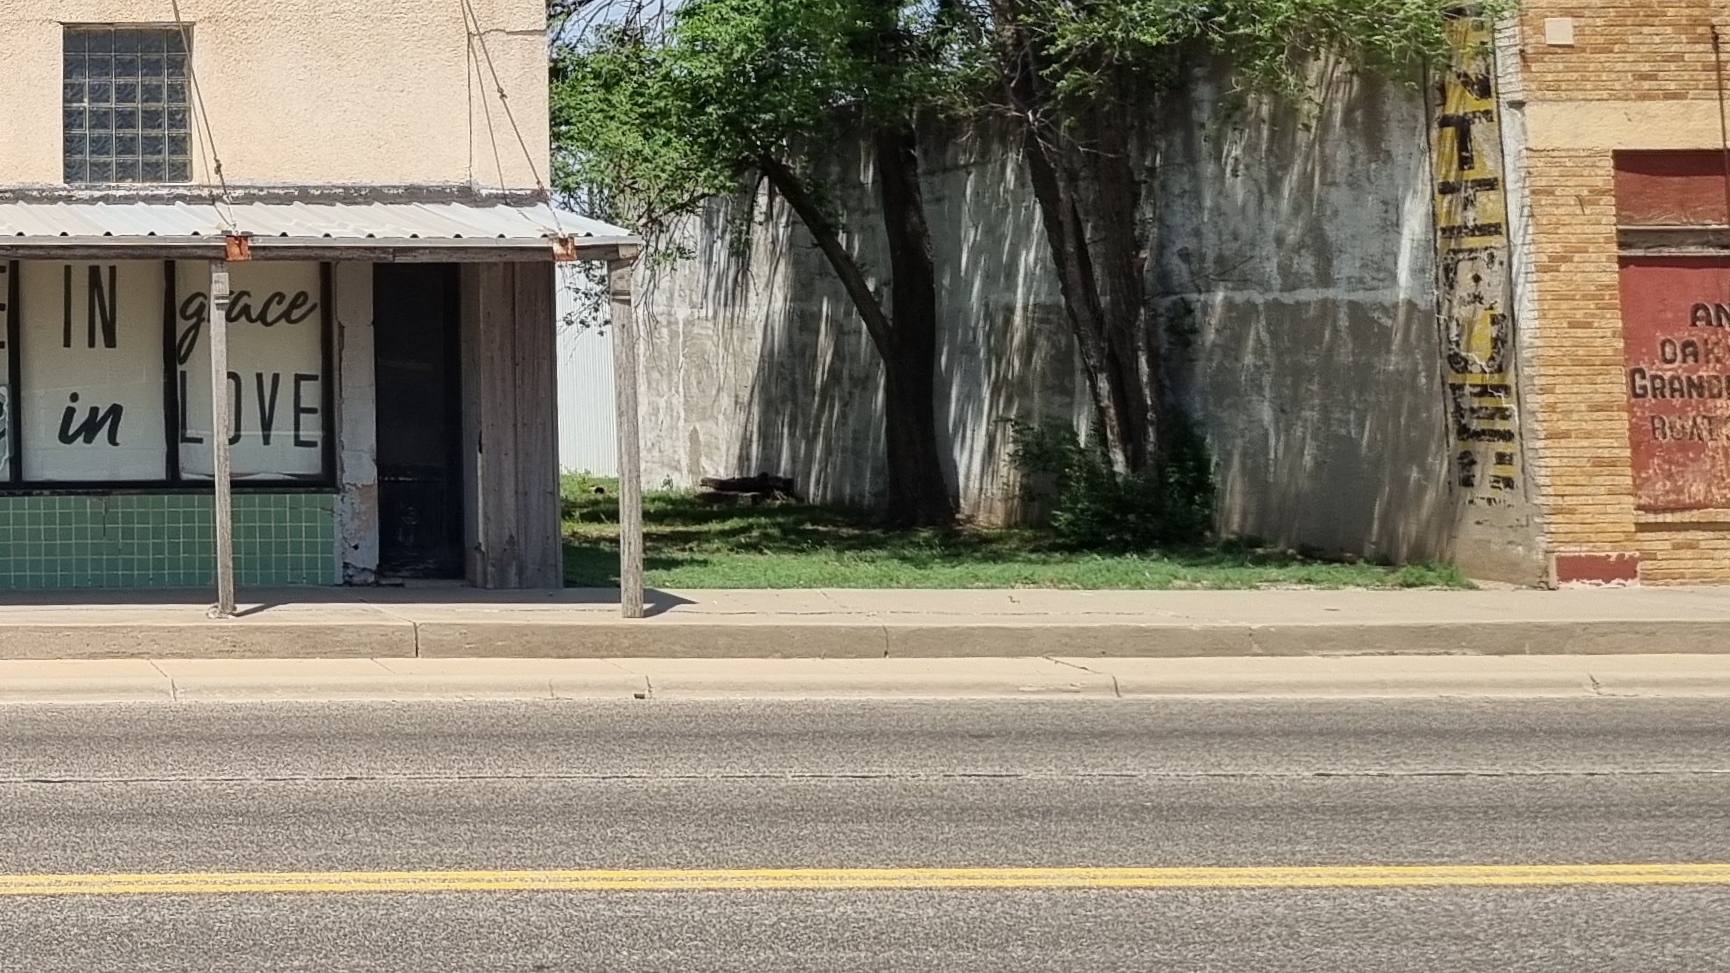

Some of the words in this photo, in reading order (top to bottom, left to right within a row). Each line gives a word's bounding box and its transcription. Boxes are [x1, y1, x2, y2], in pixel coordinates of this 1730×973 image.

[62, 264, 118, 349] IN
[177, 289, 318, 366] gace
[57, 391, 124, 447] in
[179, 370, 320, 448] LOVE
